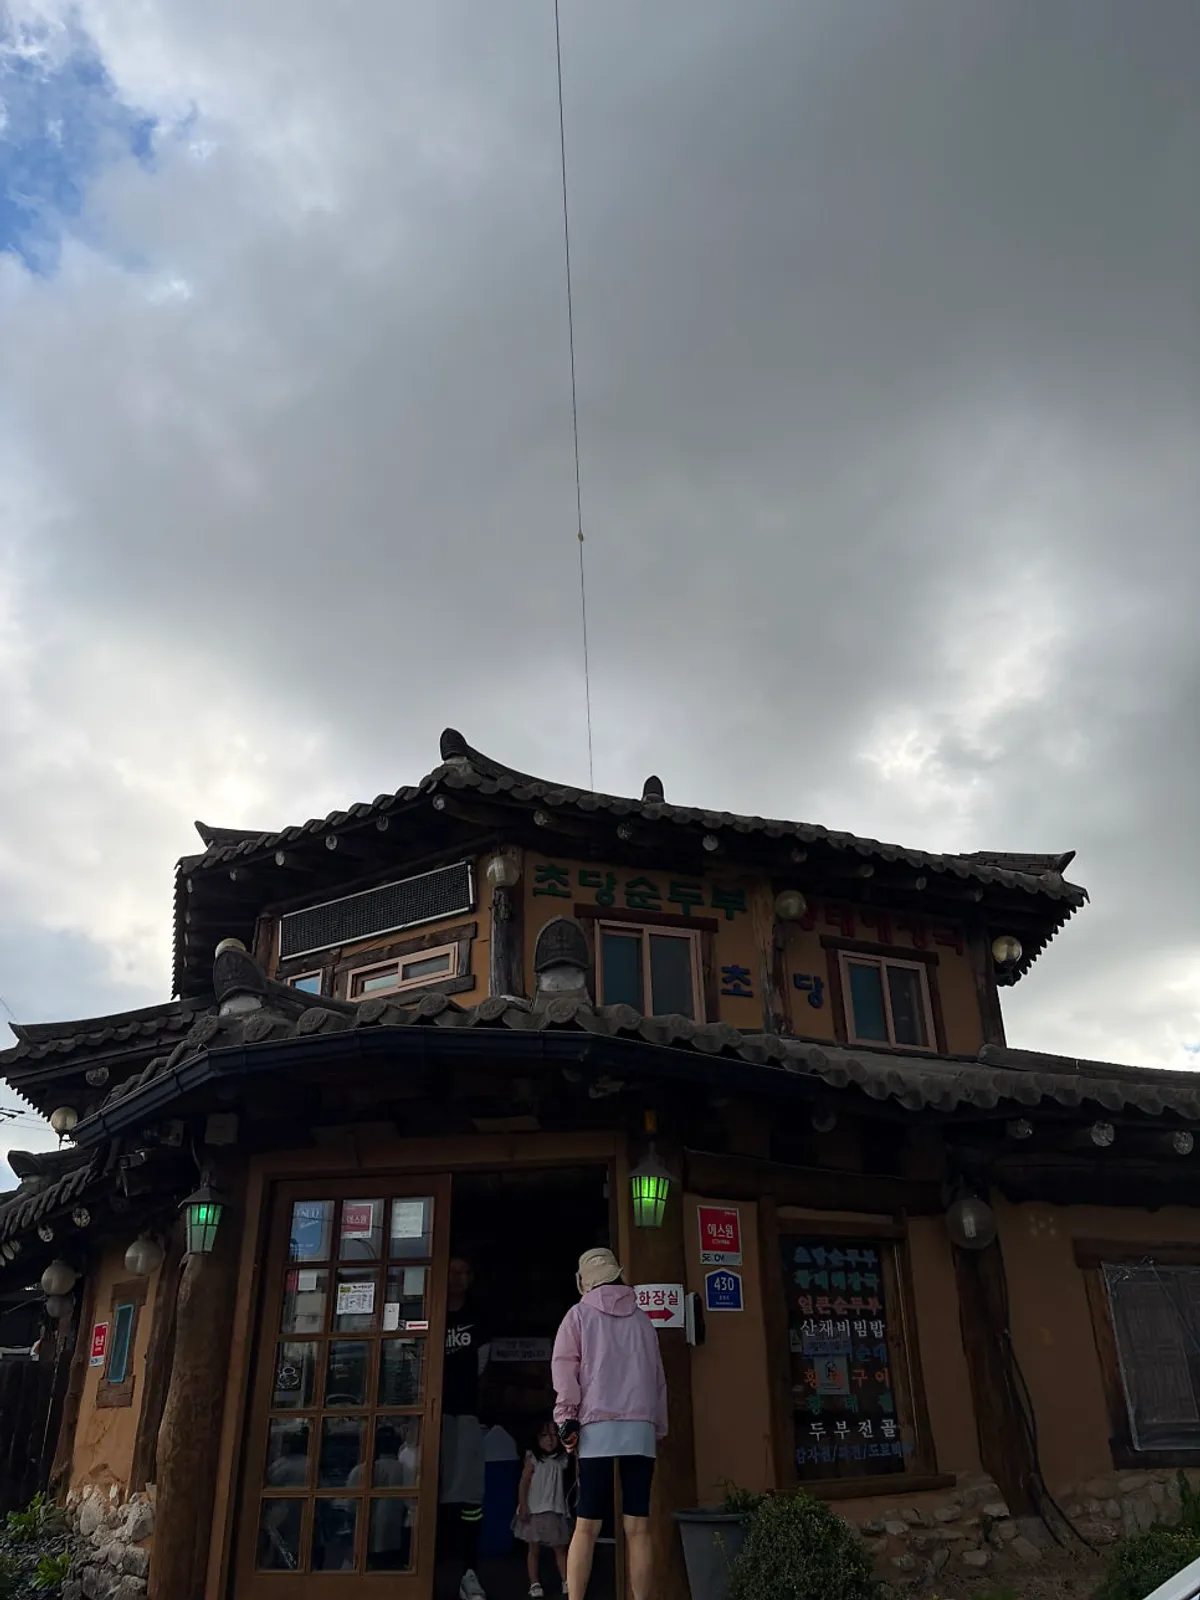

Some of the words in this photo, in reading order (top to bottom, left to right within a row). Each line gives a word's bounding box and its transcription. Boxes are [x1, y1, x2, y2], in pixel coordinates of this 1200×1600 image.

[532, 863, 747, 920] 초당순두부
[707, 1223, 734, 1239] 에스원
[713, 1276, 735, 1291] 430
[639, 1290, 679, 1306] 화장실
[800, 1318, 885, 1339] 산채비빔밥
[808, 1418, 897, 1442] 두부전골
